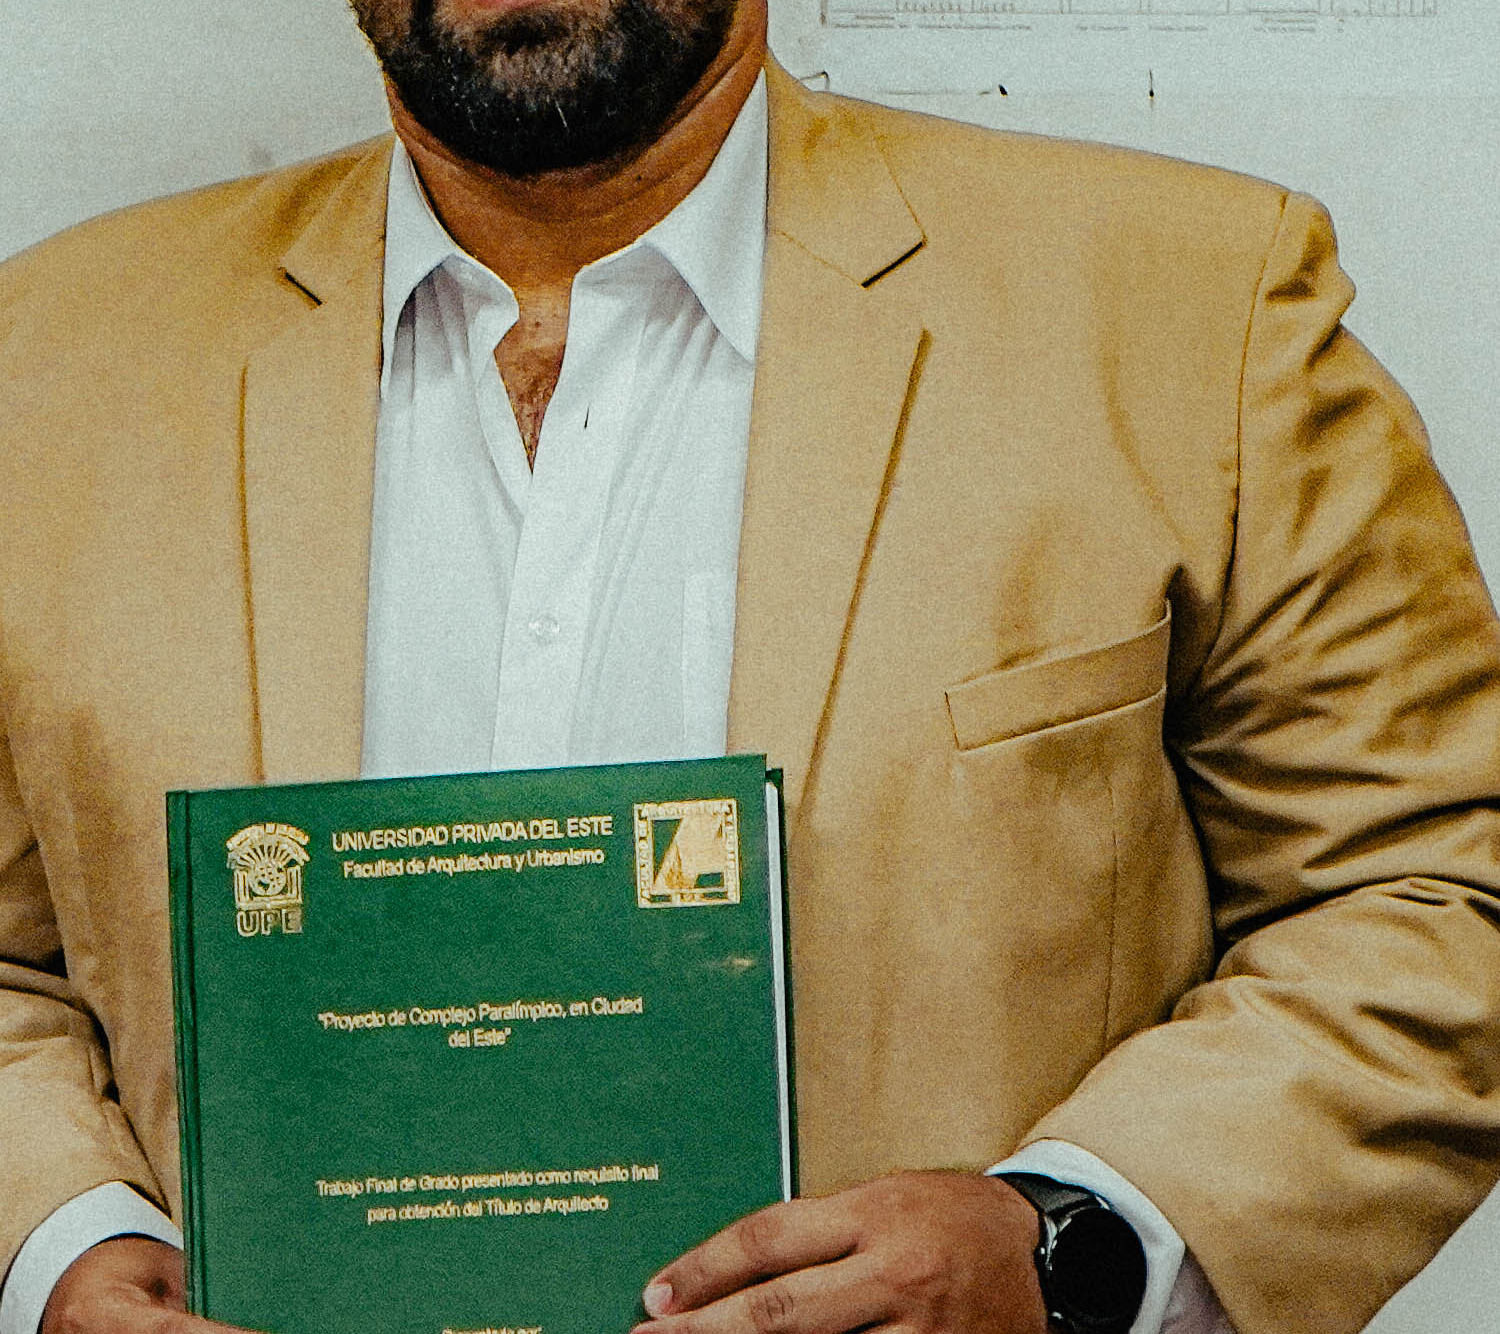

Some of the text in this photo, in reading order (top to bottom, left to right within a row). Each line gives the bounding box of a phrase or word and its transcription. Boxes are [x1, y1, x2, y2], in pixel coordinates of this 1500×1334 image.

[332, 825, 450, 852] UNIVERSIDAD
[451, 820, 530, 844] PRIVADA
[528, 818, 566, 840] DEL
[566, 815, 613, 838] ESTE
[343, 848, 605, 878] Facultad de Arquitectura y Urbanismo
[236, 907, 303, 937] UPE
[386, 1009, 407, 1026] de
[408, 1006, 477, 1028] Complejo
[568, 1001, 589, 1017] en
[590, 996, 643, 1016] Ciudad
[448, 1030, 473, 1048] del
[316, 1164, 659, 1198] Trabajo Final de Grado presentado como requisito final
[367, 1194, 609, 1225] para obtención del Título de Arquitecto
